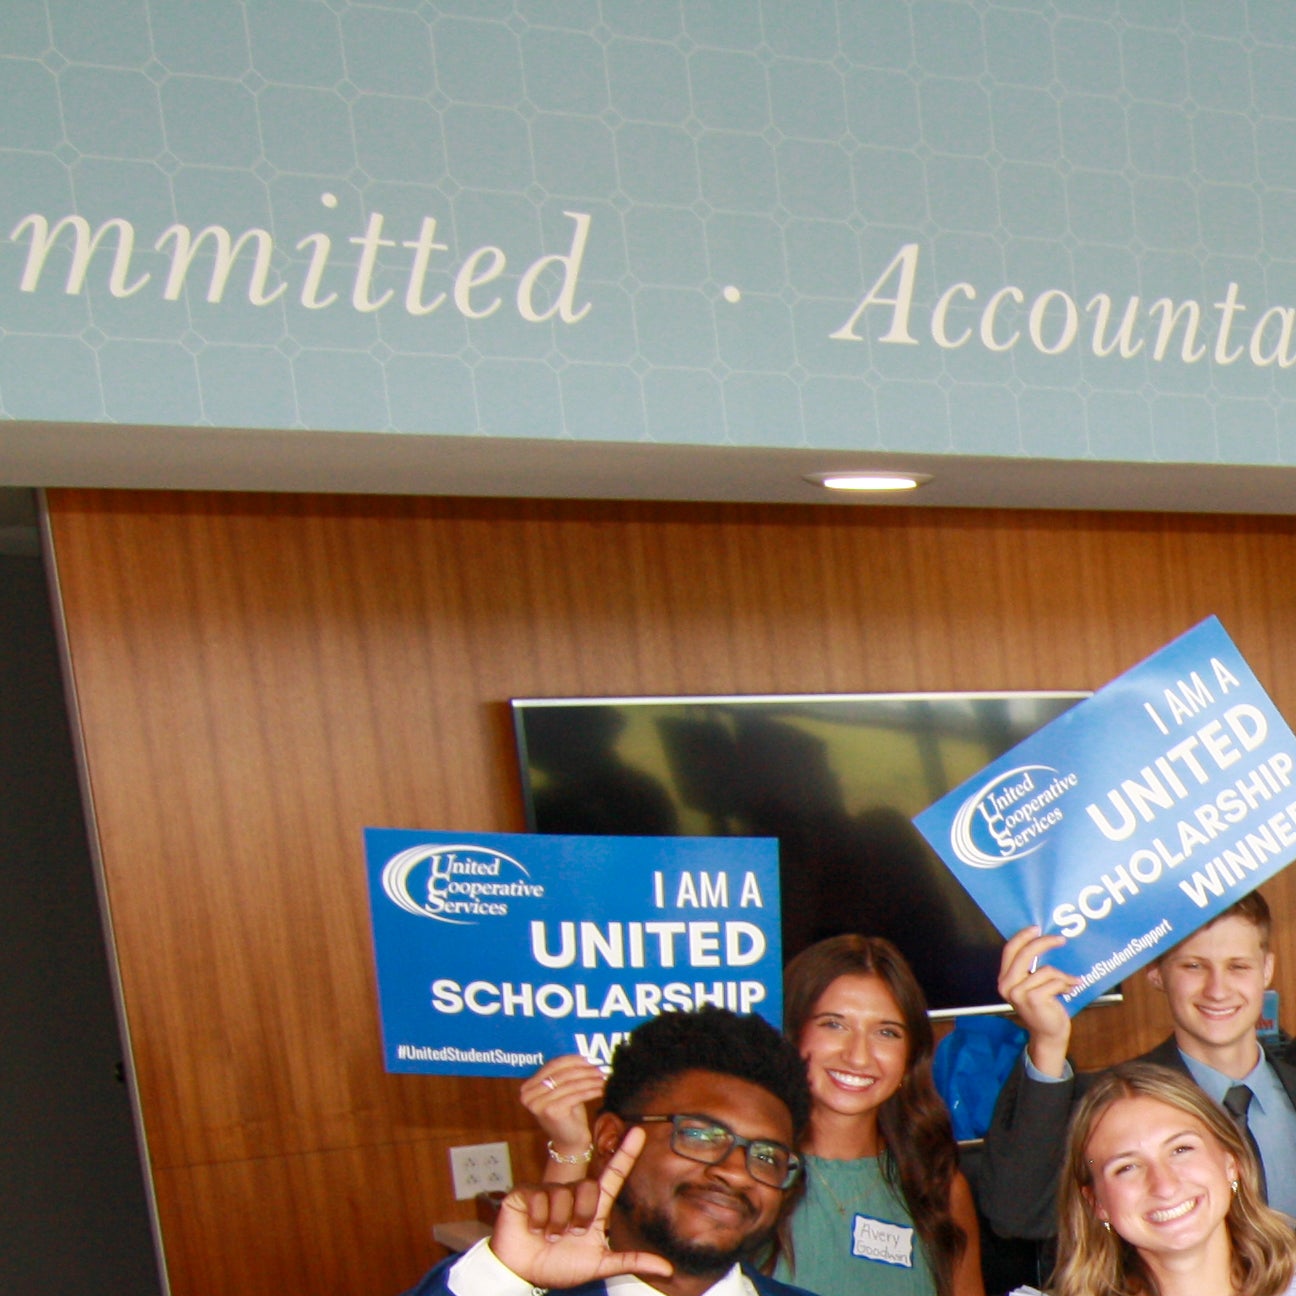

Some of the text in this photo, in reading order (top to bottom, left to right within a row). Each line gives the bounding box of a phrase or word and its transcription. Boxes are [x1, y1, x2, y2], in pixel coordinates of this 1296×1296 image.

[1144, 657, 1239, 735] I AM A
[1086, 704, 1268, 842] UNITED
[977, 771, 1034, 823] United
[988, 770, 1077, 840] Cooperative
[999, 807, 1064, 857] Services
[1052, 752, 1293, 939] SCHOLARSHIP
[427, 877, 544, 898] Cooperative
[431, 854, 499, 879] United
[425, 894, 507, 915] Services
[653, 871, 763, 908] I AM A
[530, 921, 767, 968] UNITED
[431, 979, 766, 1018] SCHOLARSHIP
[398, 1044, 544, 1065] #UnitedStudentSupport
[860, 1223, 900, 1247] Avery
